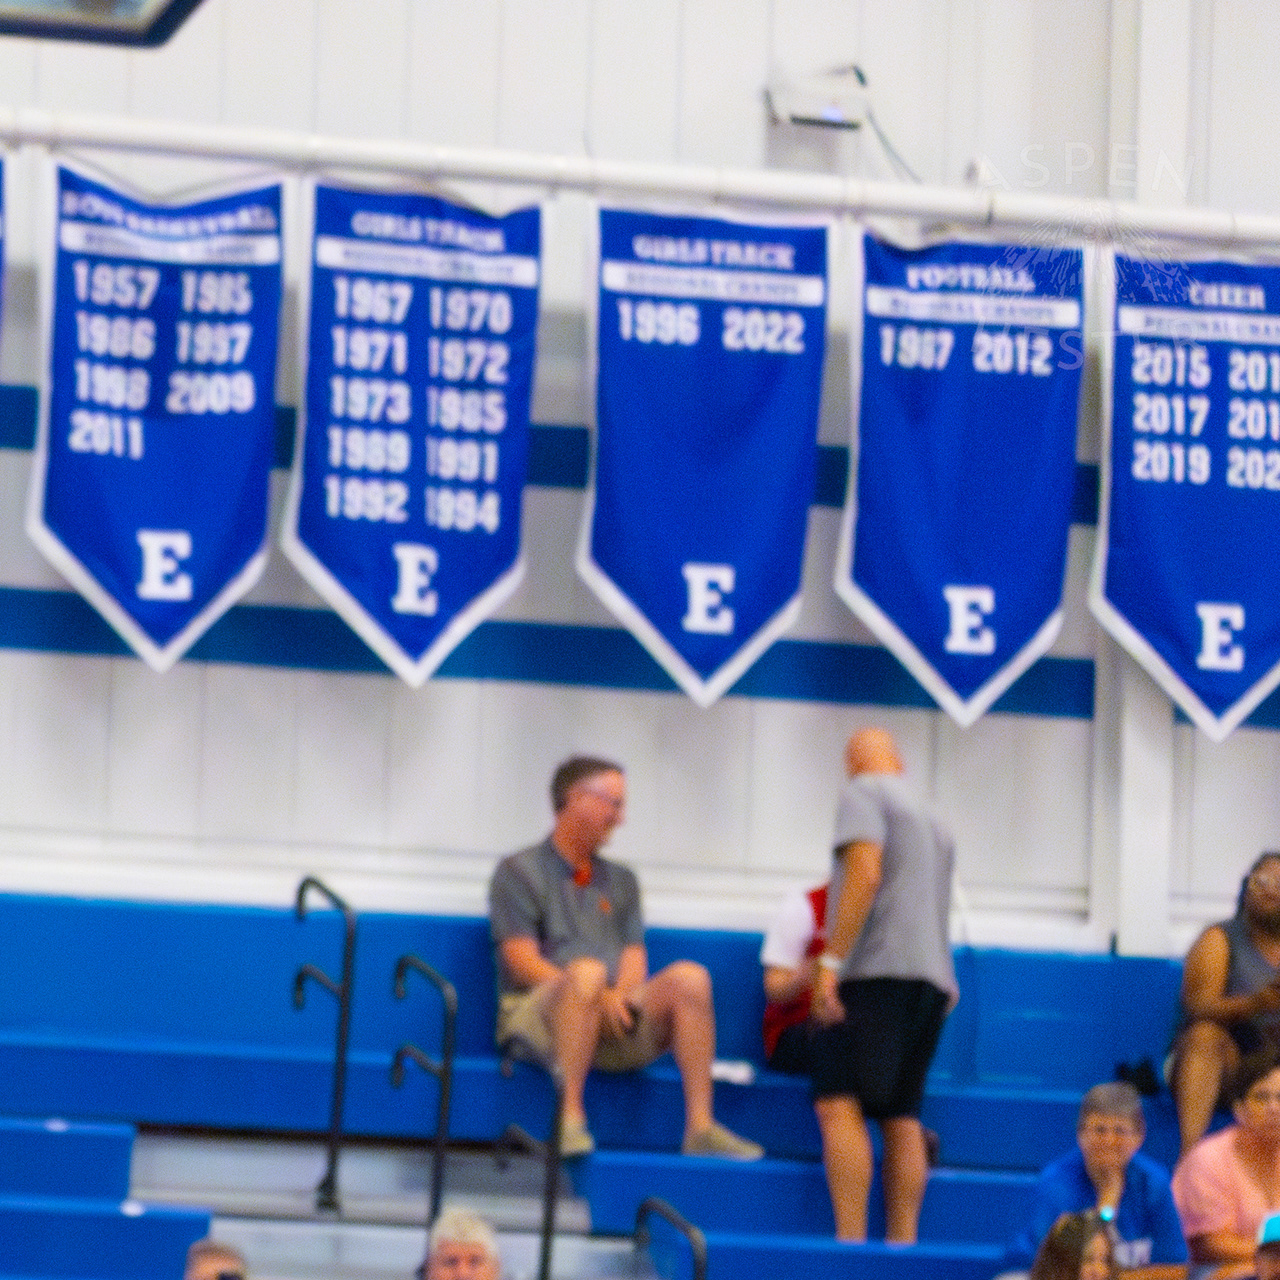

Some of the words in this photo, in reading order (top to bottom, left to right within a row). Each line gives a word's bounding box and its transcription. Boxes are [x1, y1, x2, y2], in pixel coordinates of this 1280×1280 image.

[73, 258, 160, 310] 1957
[429, 286, 513, 334] 1970
[616, 298, 700, 346] 1996
[722, 306, 805, 354] 2022
[331, 324, 408, 375] 1971
[428, 335, 509, 384] 1972
[973, 331, 1053, 376] 2012
[1132, 343, 1211, 389] 2015
[166, 368, 256, 414] 2009
[331, 375, 411, 424] 1973
[1133, 391, 1210, 437] 2017
[68, 408, 144, 460] 2011
[1132, 438, 1211, 485] 2019
[424, 486, 501, 535] 1994
[138, 530, 192, 601] E
[391, 541, 439, 616] E
[681, 562, 734, 634] E
[943, 585, 995, 655] E
[1196, 602, 1245, 671] E
